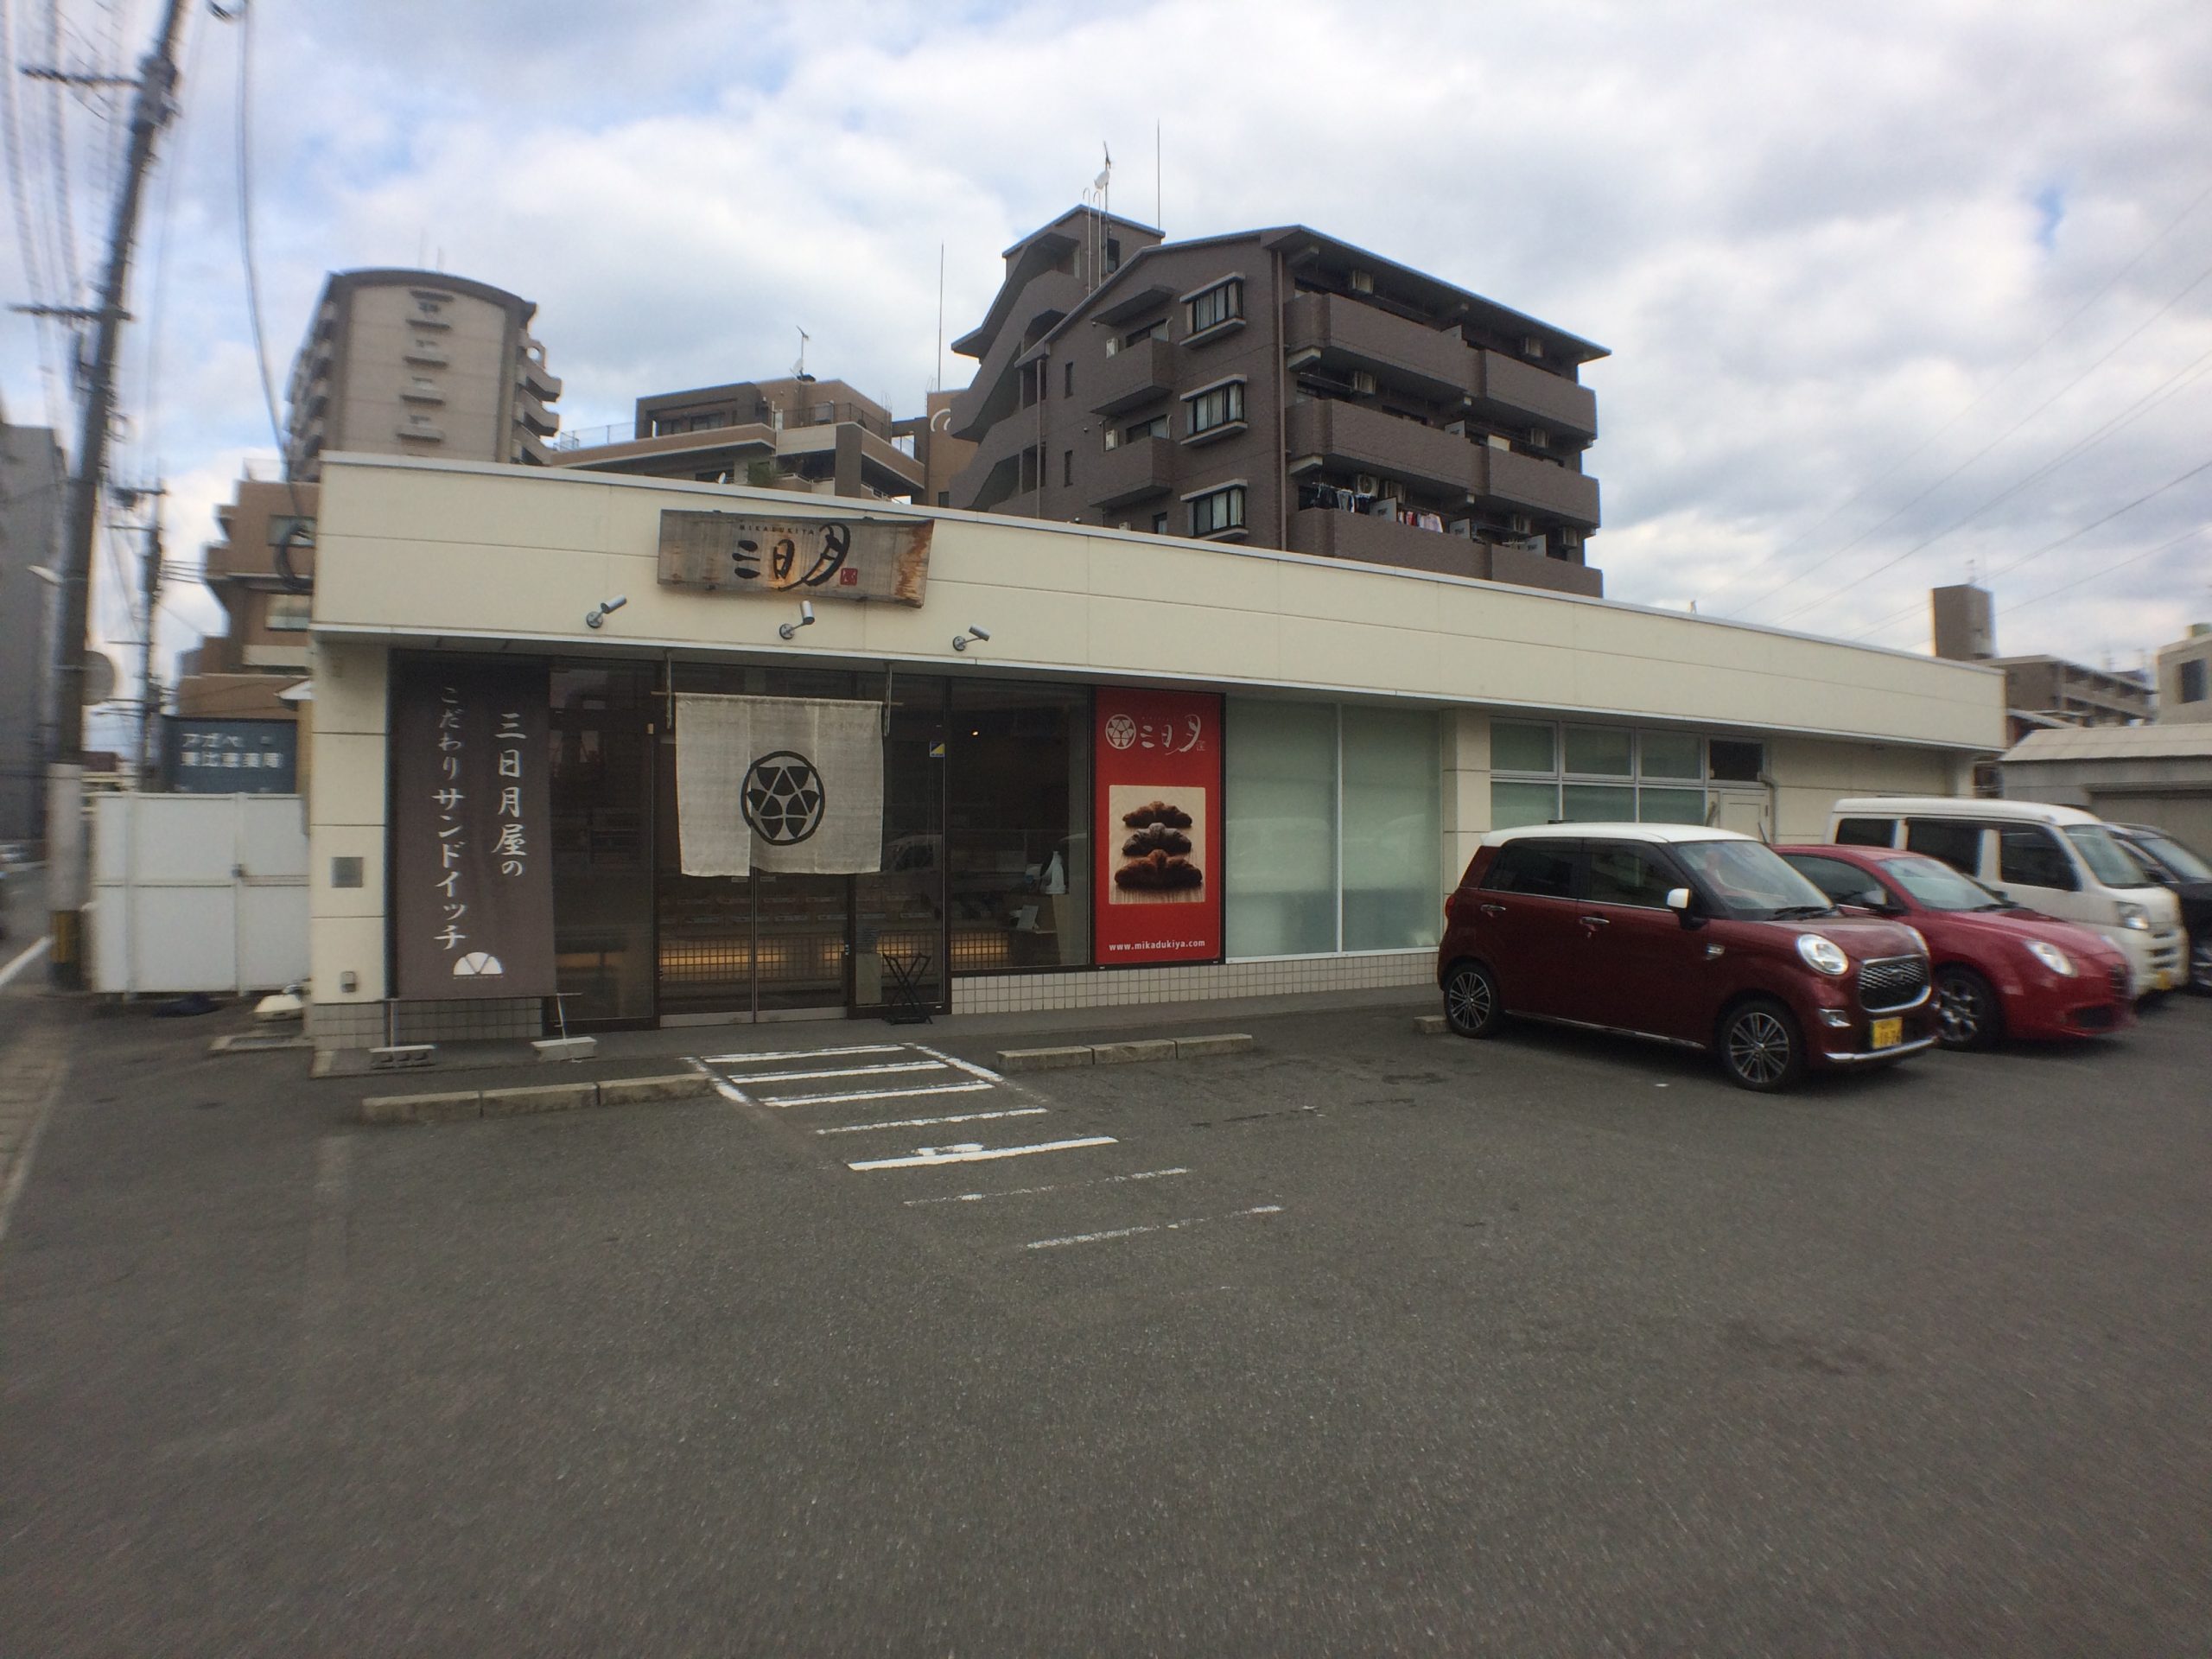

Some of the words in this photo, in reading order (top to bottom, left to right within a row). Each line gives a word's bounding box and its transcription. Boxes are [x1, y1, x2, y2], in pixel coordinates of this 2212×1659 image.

[431, 687, 467, 950] こだわりサンドイッチ
[491, 712, 529, 878] 三日月屋の
[1109, 940, 1205, 950] www.mikadukiya.com
